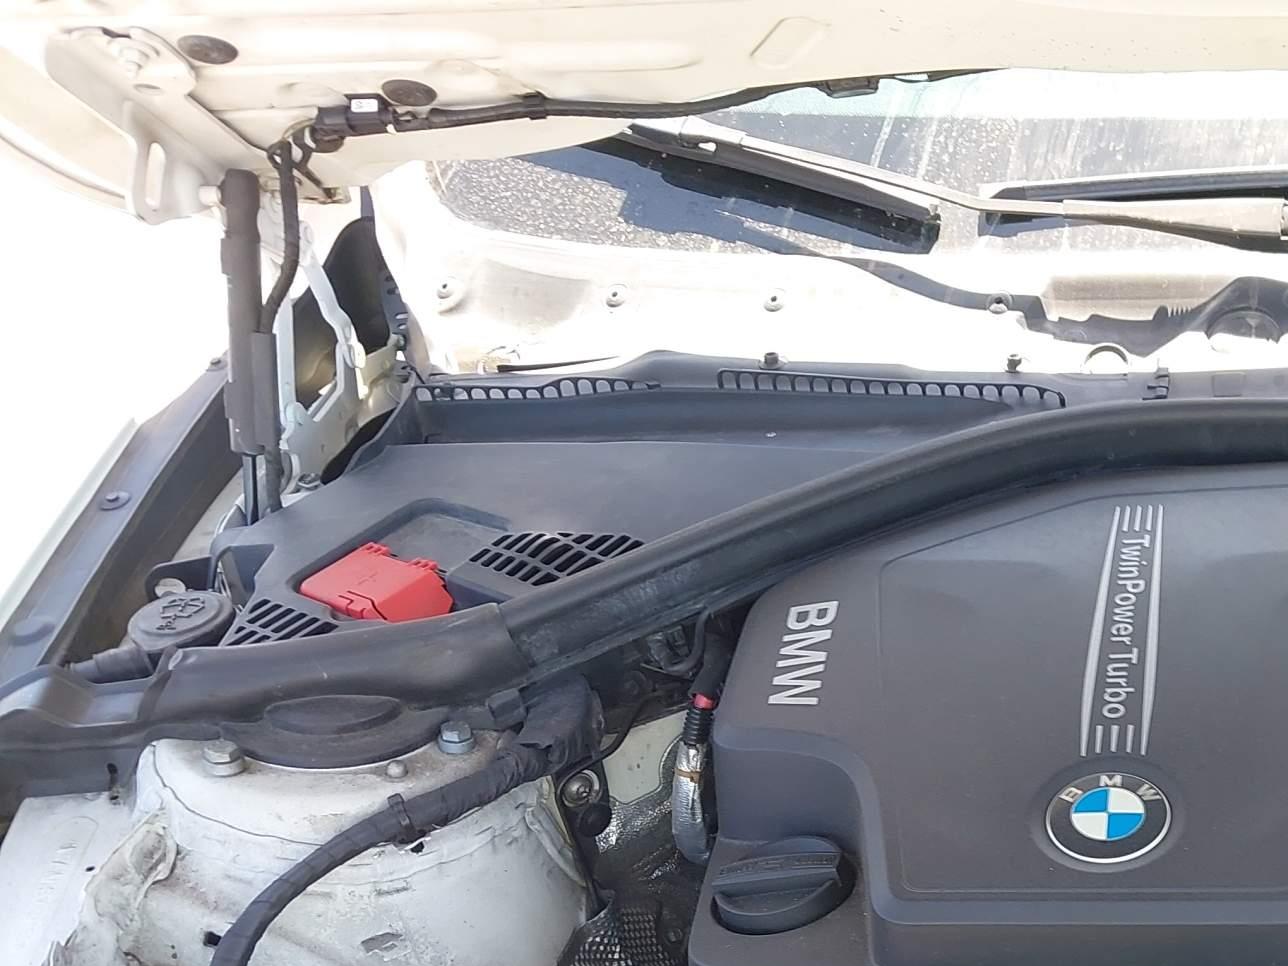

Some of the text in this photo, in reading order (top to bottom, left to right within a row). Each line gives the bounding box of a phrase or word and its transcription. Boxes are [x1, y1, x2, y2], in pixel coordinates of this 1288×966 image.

[768, 600, 839, 706] BMW
[1101, 534, 1151, 719] TwinPower Turbo
[1058, 774, 1162, 803] BMW
